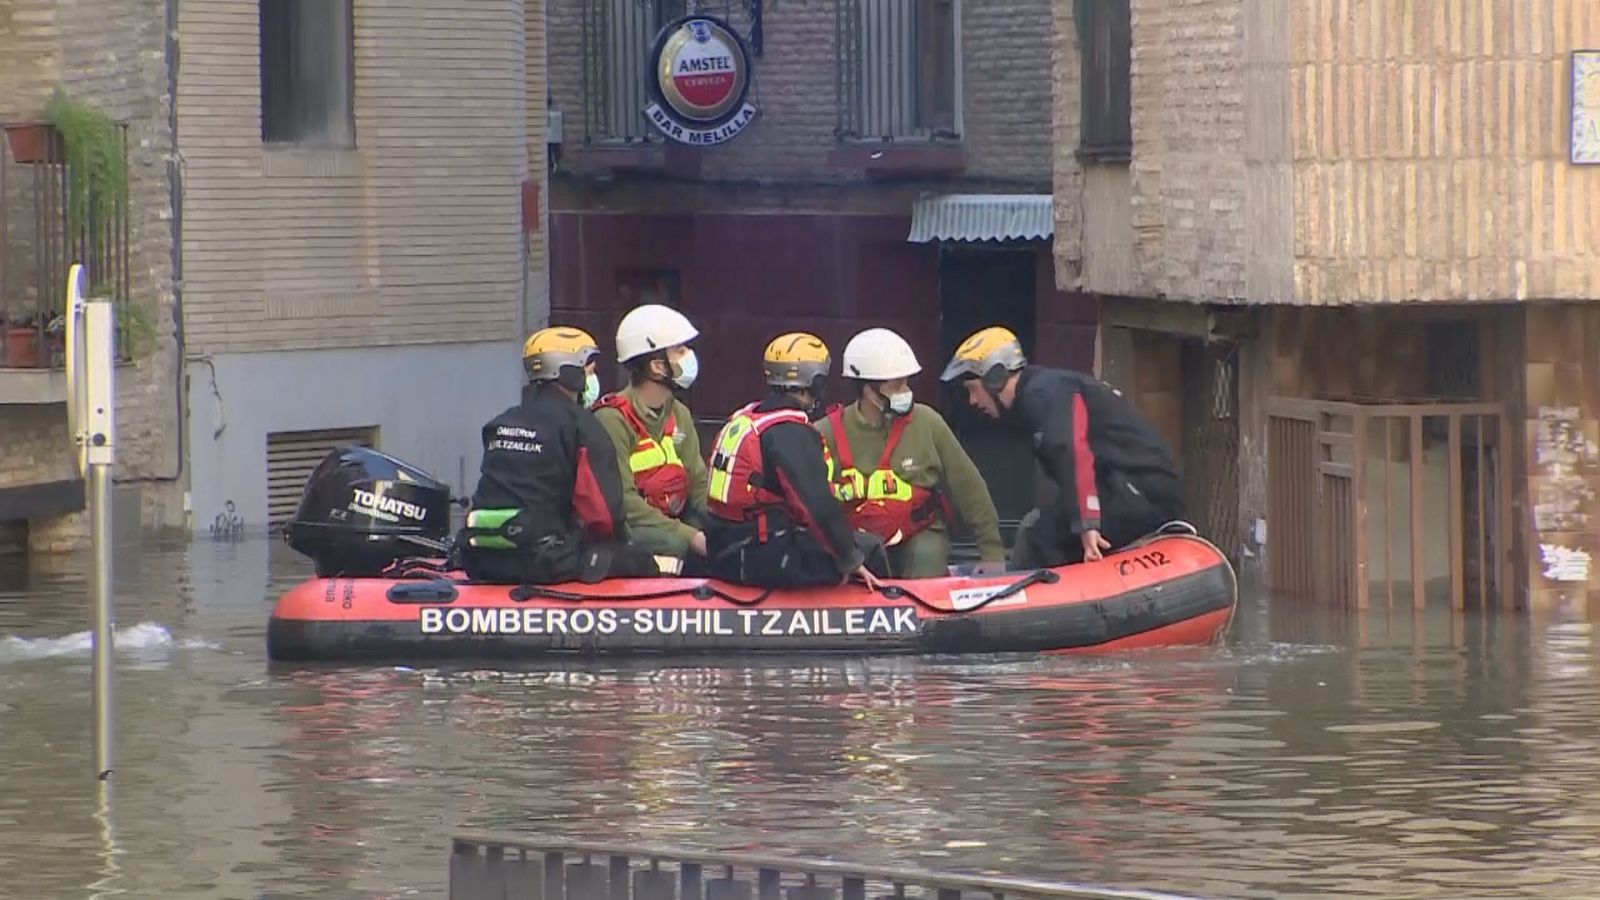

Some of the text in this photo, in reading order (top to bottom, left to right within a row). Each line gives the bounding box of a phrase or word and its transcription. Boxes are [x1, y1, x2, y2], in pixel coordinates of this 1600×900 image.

[679, 56, 731, 72] AMSTEL
[684, 77, 726, 88] CERVEZA
[653, 108, 753, 142] BAR MELILLA
[353, 489, 427, 521] TOHATSU
[1133, 551, 1171, 569] 112
